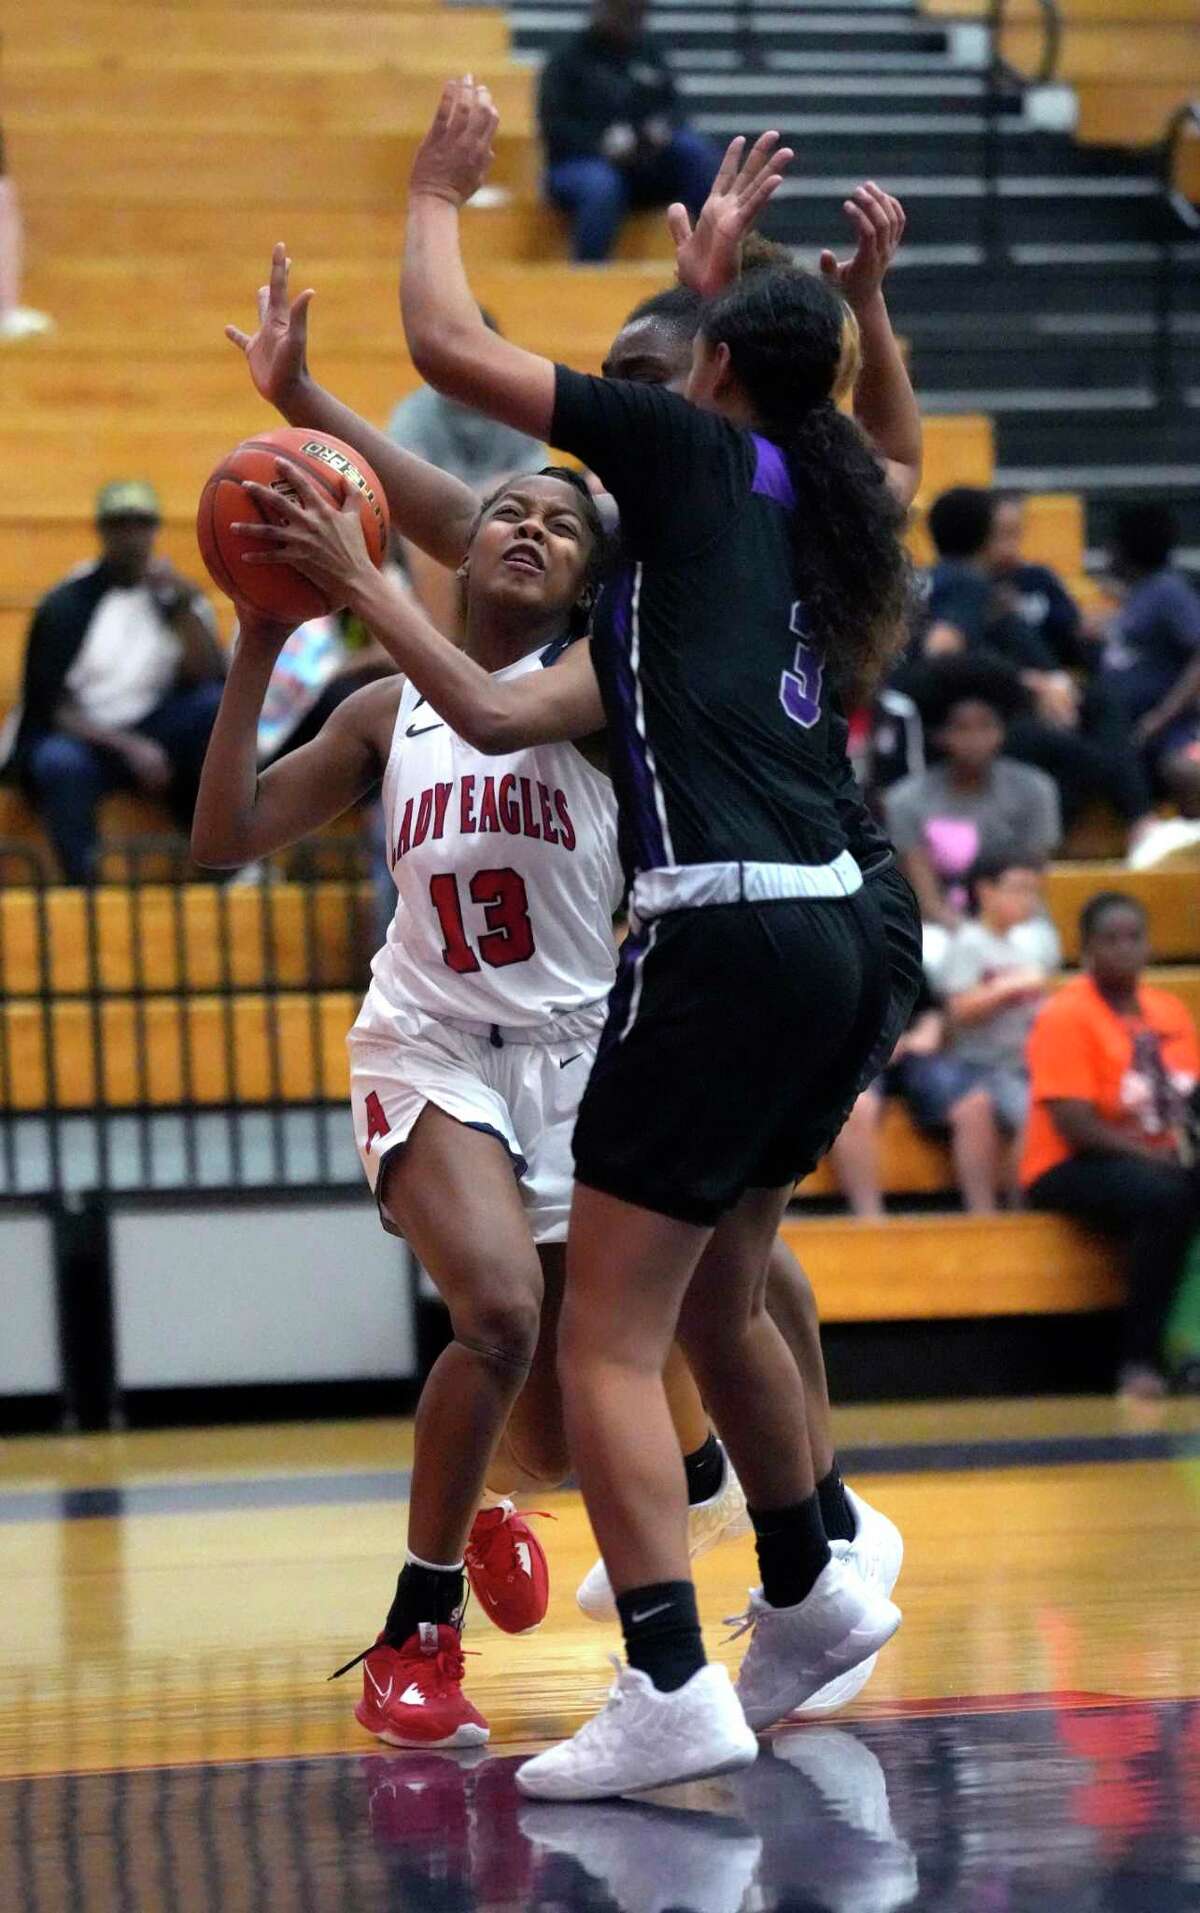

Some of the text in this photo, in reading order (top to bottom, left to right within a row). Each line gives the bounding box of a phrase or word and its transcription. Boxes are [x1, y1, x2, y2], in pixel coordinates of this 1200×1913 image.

[392, 773, 576, 872] ADY EAGLES
[429, 867, 536, 974] 13
[364, 1090, 391, 1155] A
